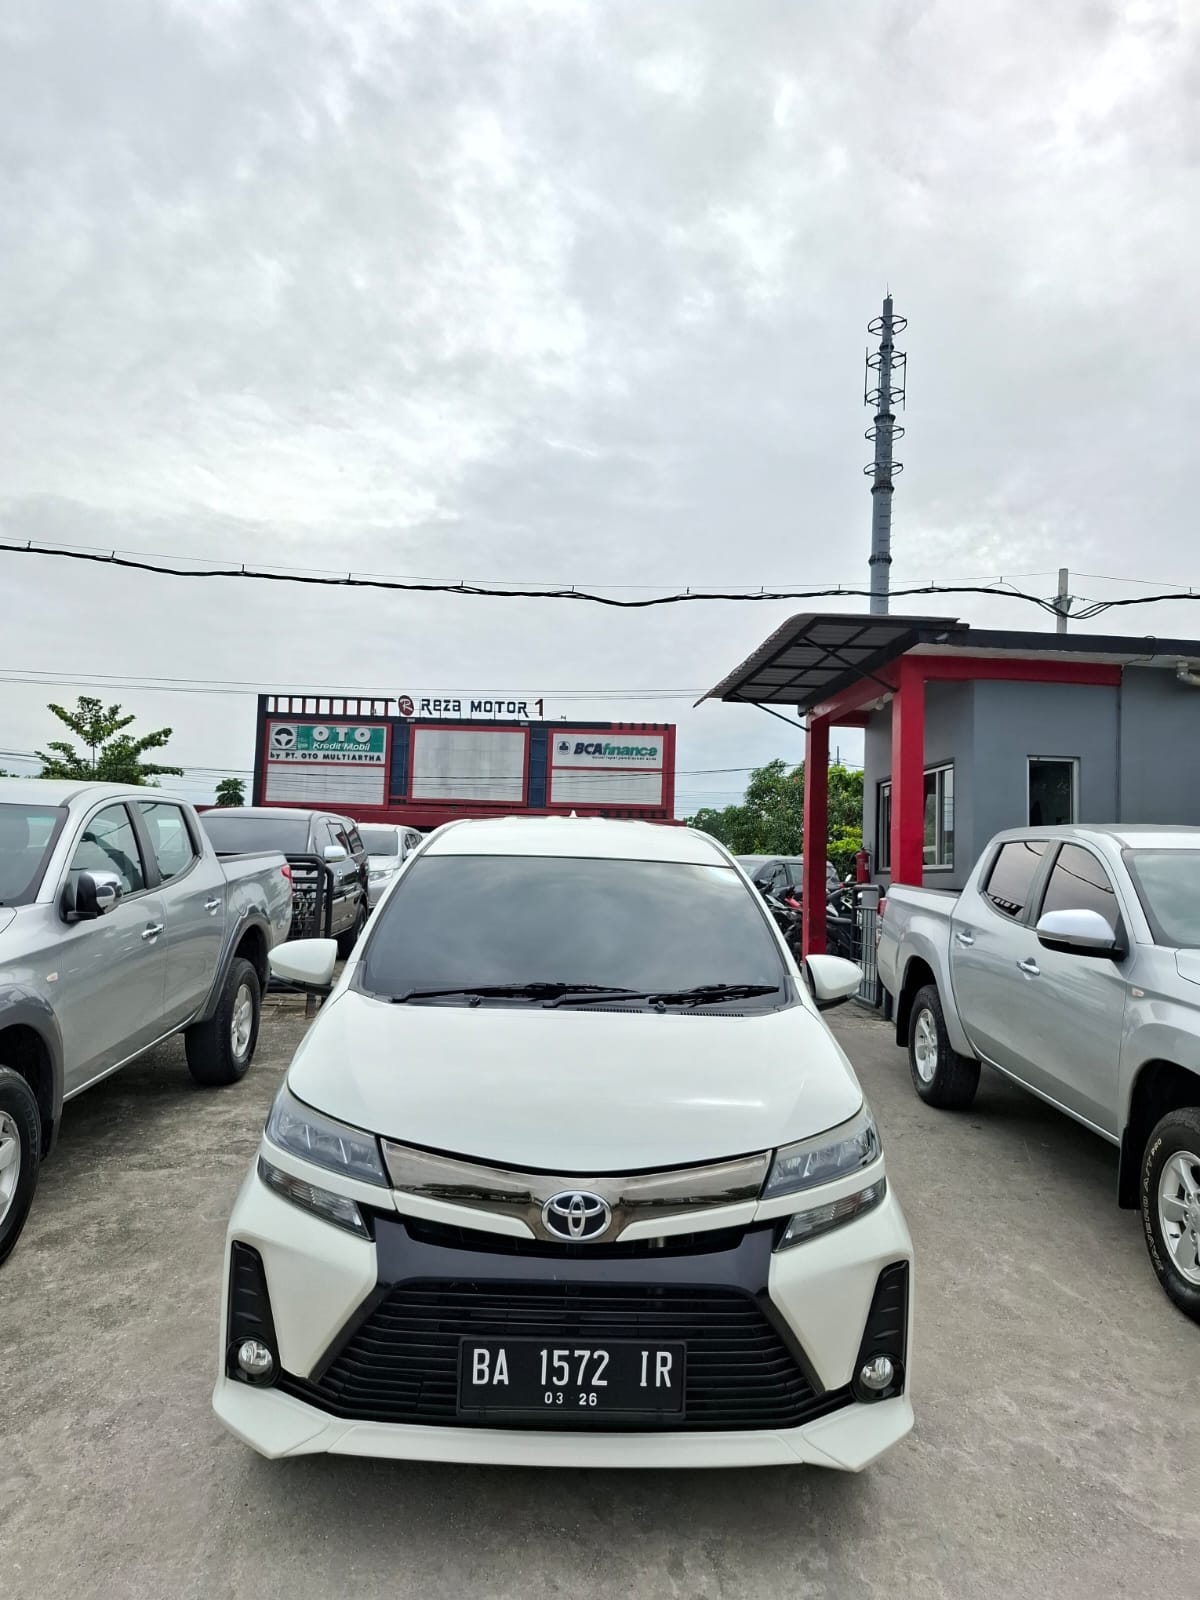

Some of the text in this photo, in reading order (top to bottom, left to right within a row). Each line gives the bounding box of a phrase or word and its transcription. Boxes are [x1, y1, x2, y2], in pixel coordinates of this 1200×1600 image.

[470, 700, 529, 718] MOTOR
[534, 698, 544, 717] 1
[312, 725, 372, 743] OTO
[312, 742, 342, 750] Kredit
[343, 743, 371, 751] Mobil
[270, 752, 281, 760] by
[301, 752, 319, 760] OTO
[322, 753, 382, 762] MULTIARTHA
[472, 1348, 673, 1388] BA 1572 IR
[544, 1391, 598, 1406] 03 26
